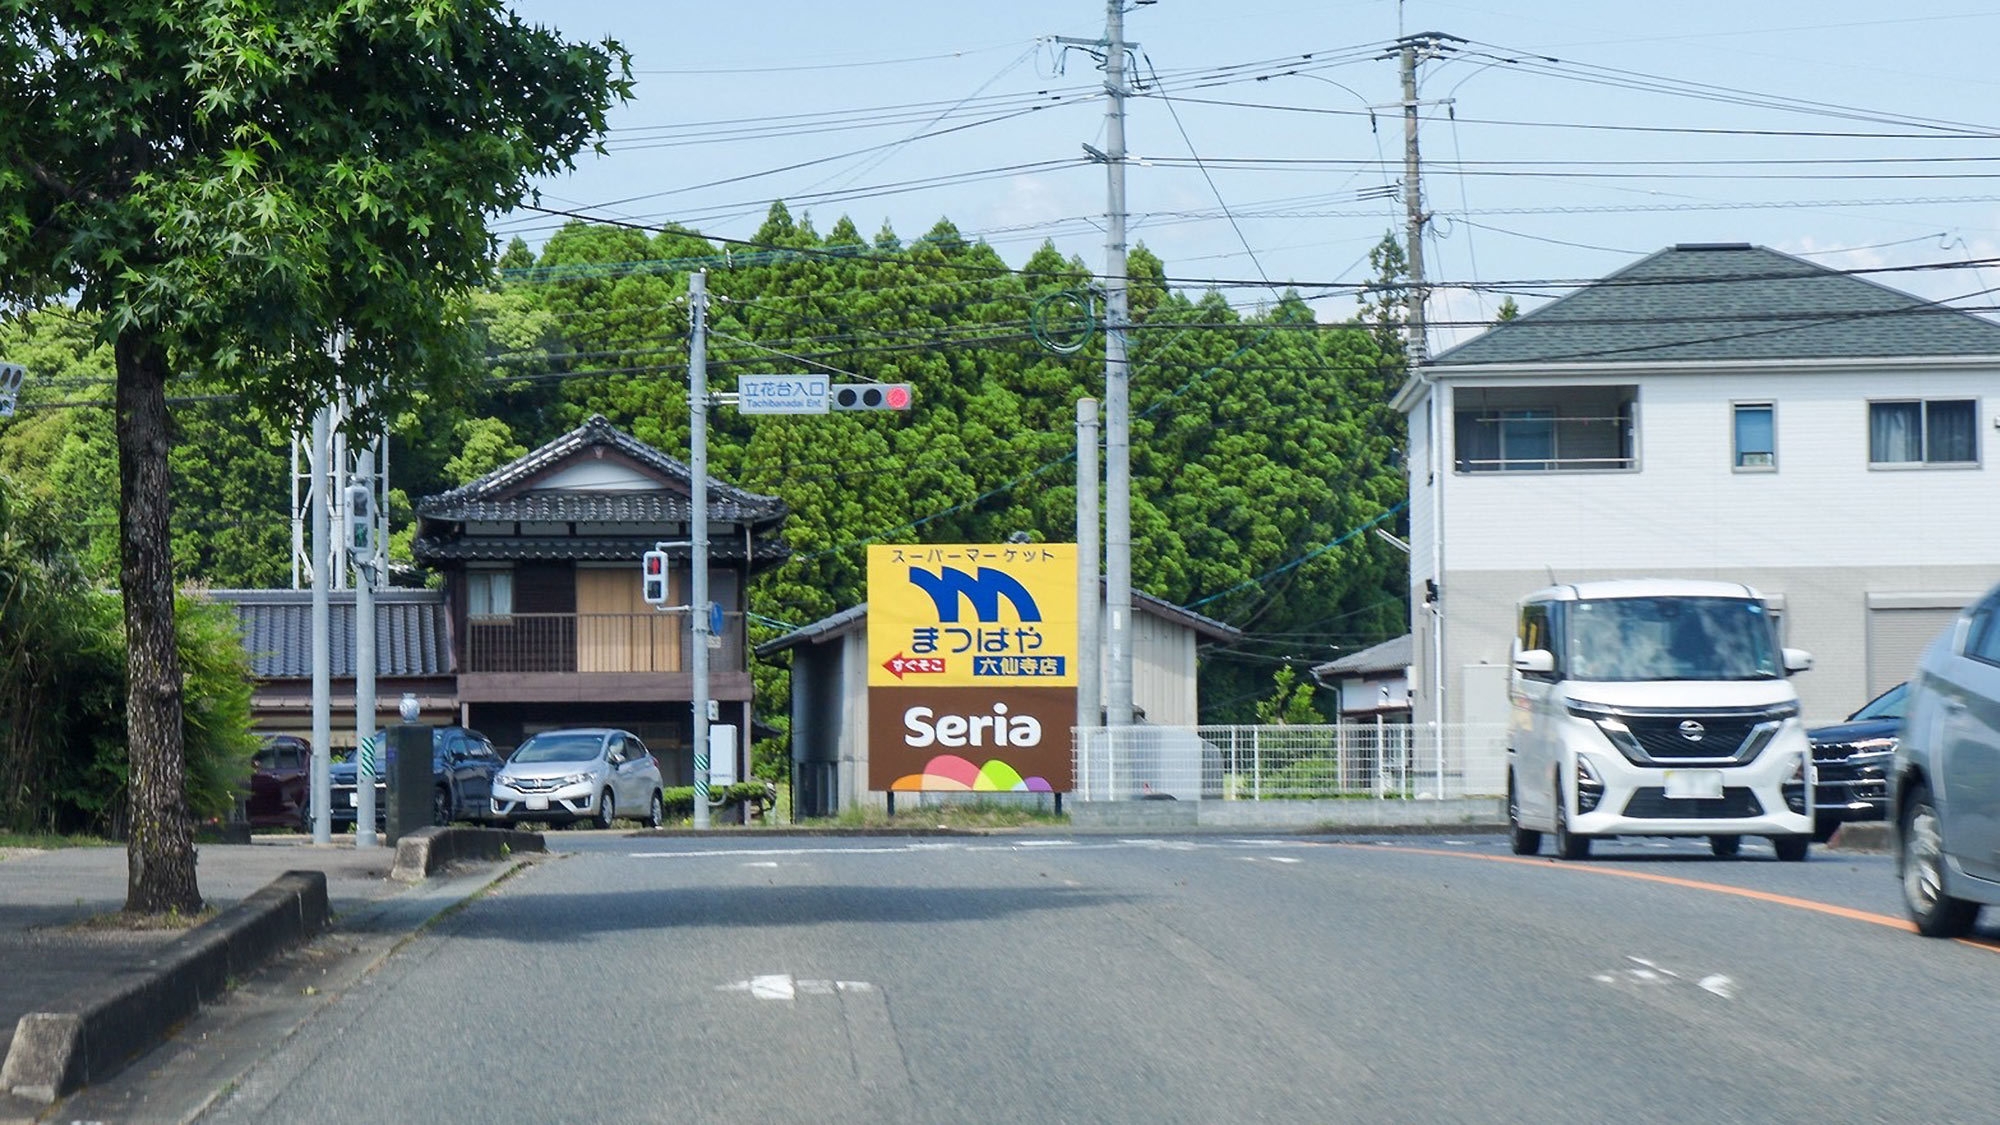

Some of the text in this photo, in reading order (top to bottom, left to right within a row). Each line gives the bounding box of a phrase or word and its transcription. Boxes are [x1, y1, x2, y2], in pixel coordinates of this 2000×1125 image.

[744, 382, 824, 396] 立花台入口
[891, 549, 1054, 563] スーパーマーケット
[892, 658, 943, 672] すぐそこ
[979, 657, 1058, 675] 六仙寺店
[904, 703, 1042, 747] Seria
